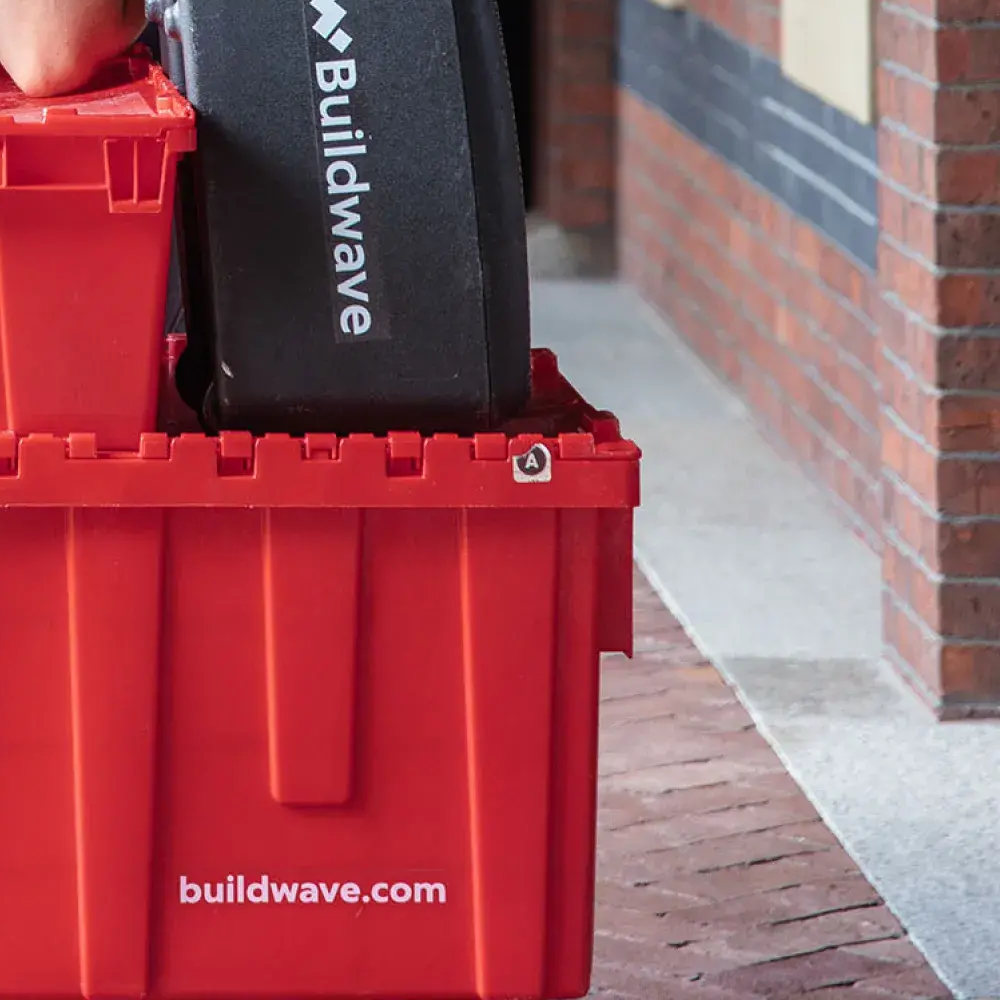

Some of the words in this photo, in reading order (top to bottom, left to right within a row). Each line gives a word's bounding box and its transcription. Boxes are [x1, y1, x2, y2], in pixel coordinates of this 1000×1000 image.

[315, 58, 372, 336] Buildwave
[524, 452, 540, 470] A
[179, 875, 447, 904] buildwave.com
